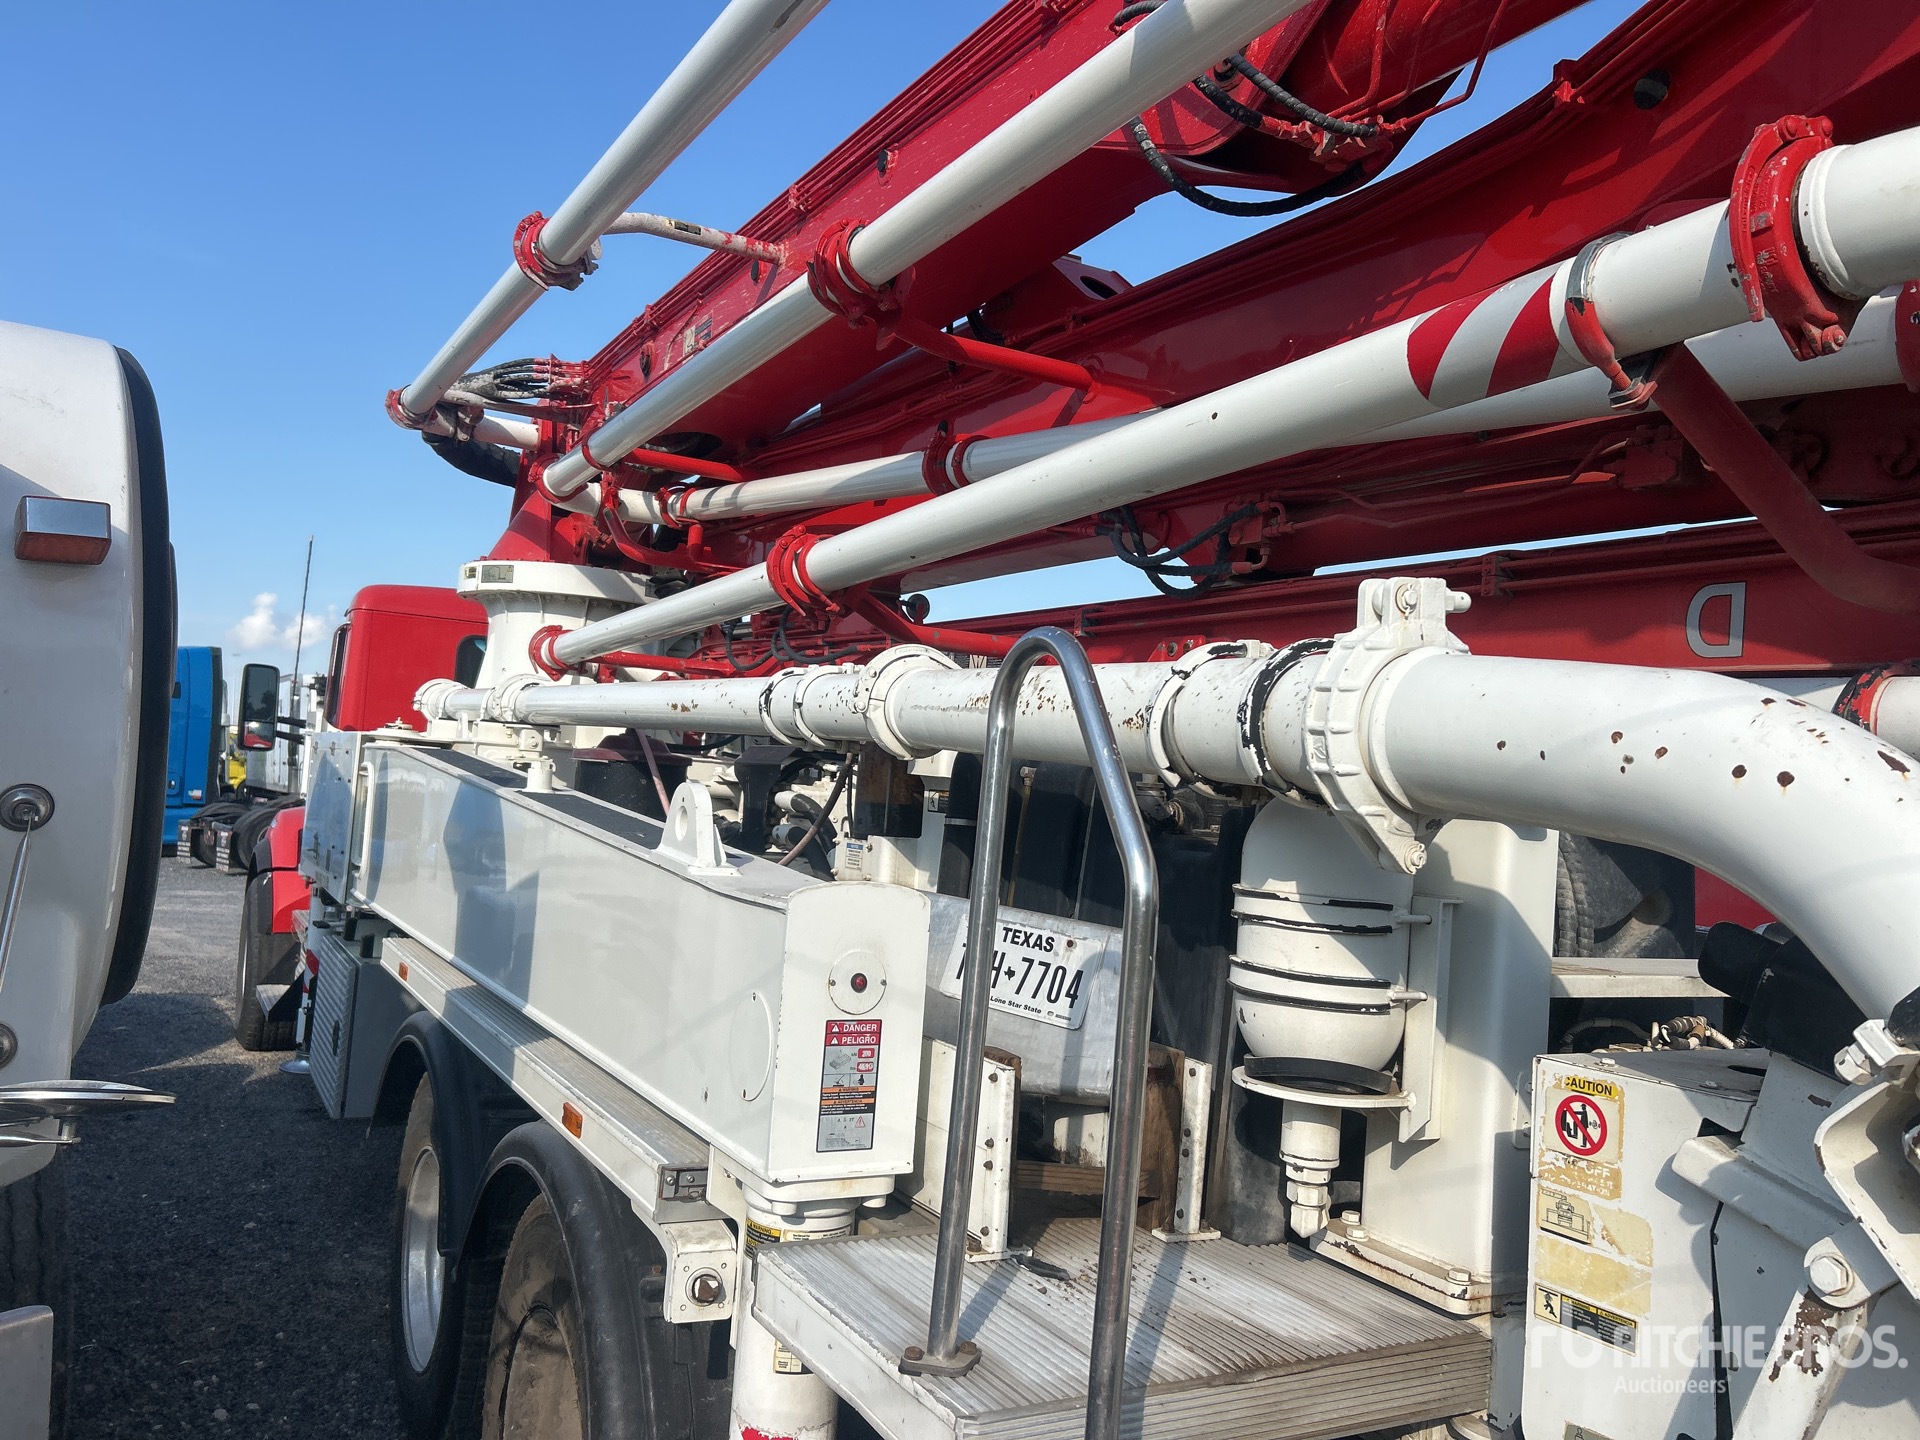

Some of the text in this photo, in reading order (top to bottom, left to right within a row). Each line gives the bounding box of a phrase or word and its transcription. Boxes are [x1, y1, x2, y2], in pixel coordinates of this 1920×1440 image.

[1002, 927, 1055, 953] TEXAS
[1015, 957, 1084, 1009] 7704
[990, 996, 1042, 1014] Lone Star State
[843, 1024, 877, 1032] DANGER
[842, 1036, 876, 1044] PELIGRO
